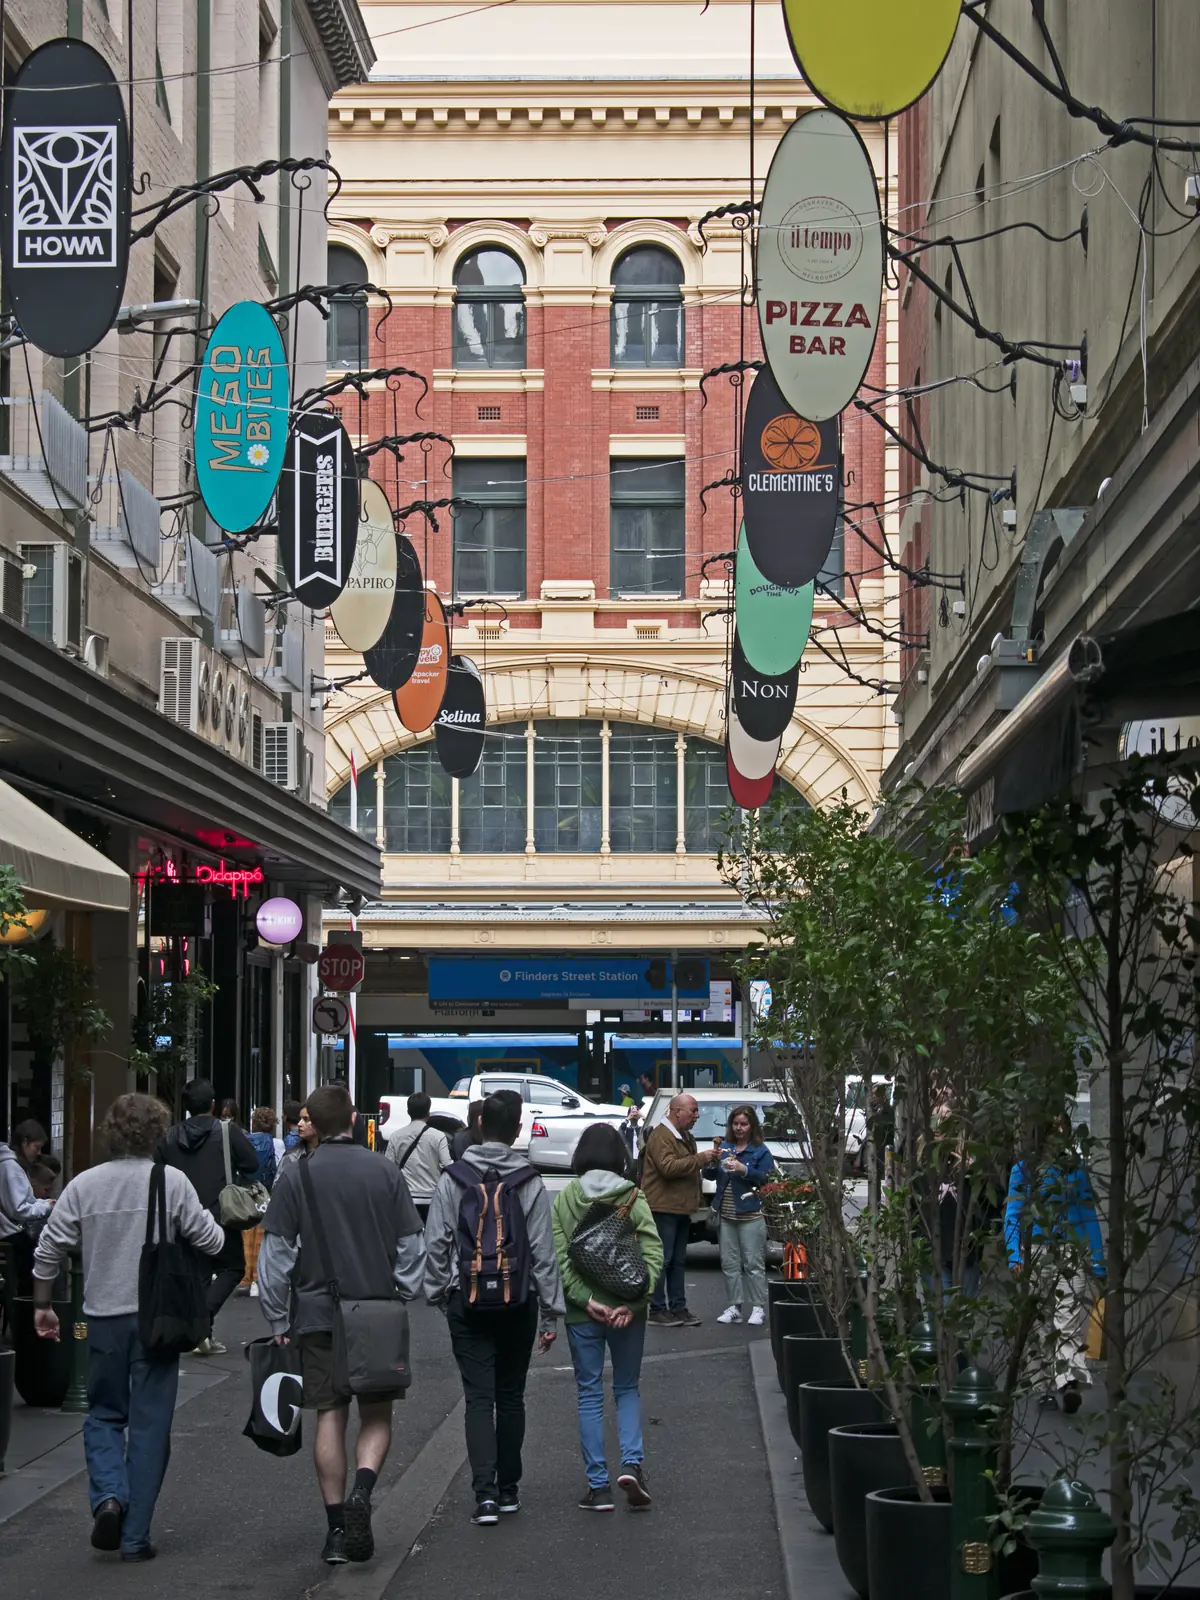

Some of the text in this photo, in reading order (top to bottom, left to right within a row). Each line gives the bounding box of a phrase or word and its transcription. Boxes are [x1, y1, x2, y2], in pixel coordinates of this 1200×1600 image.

[25, 235, 105, 256] HOWM
[791, 225, 852, 256] il tempo
[765, 300, 872, 329] PIZZA
[789, 335, 847, 356] BAR
[246, 345, 273, 440] BITES
[208, 345, 268, 473] MESO
[748, 473, 833, 492] CLEMENTINE'S
[314, 454, 334, 563] BURGERS
[346, 577, 395, 589] PAPIRO
[749, 583, 800, 596] DOUGHNUT
[419, 654, 438, 663] vels
[439, 709, 481, 723] Selina
[320, 959, 362, 978] STOP
[515, 971, 638, 981] Flinders Street Station
